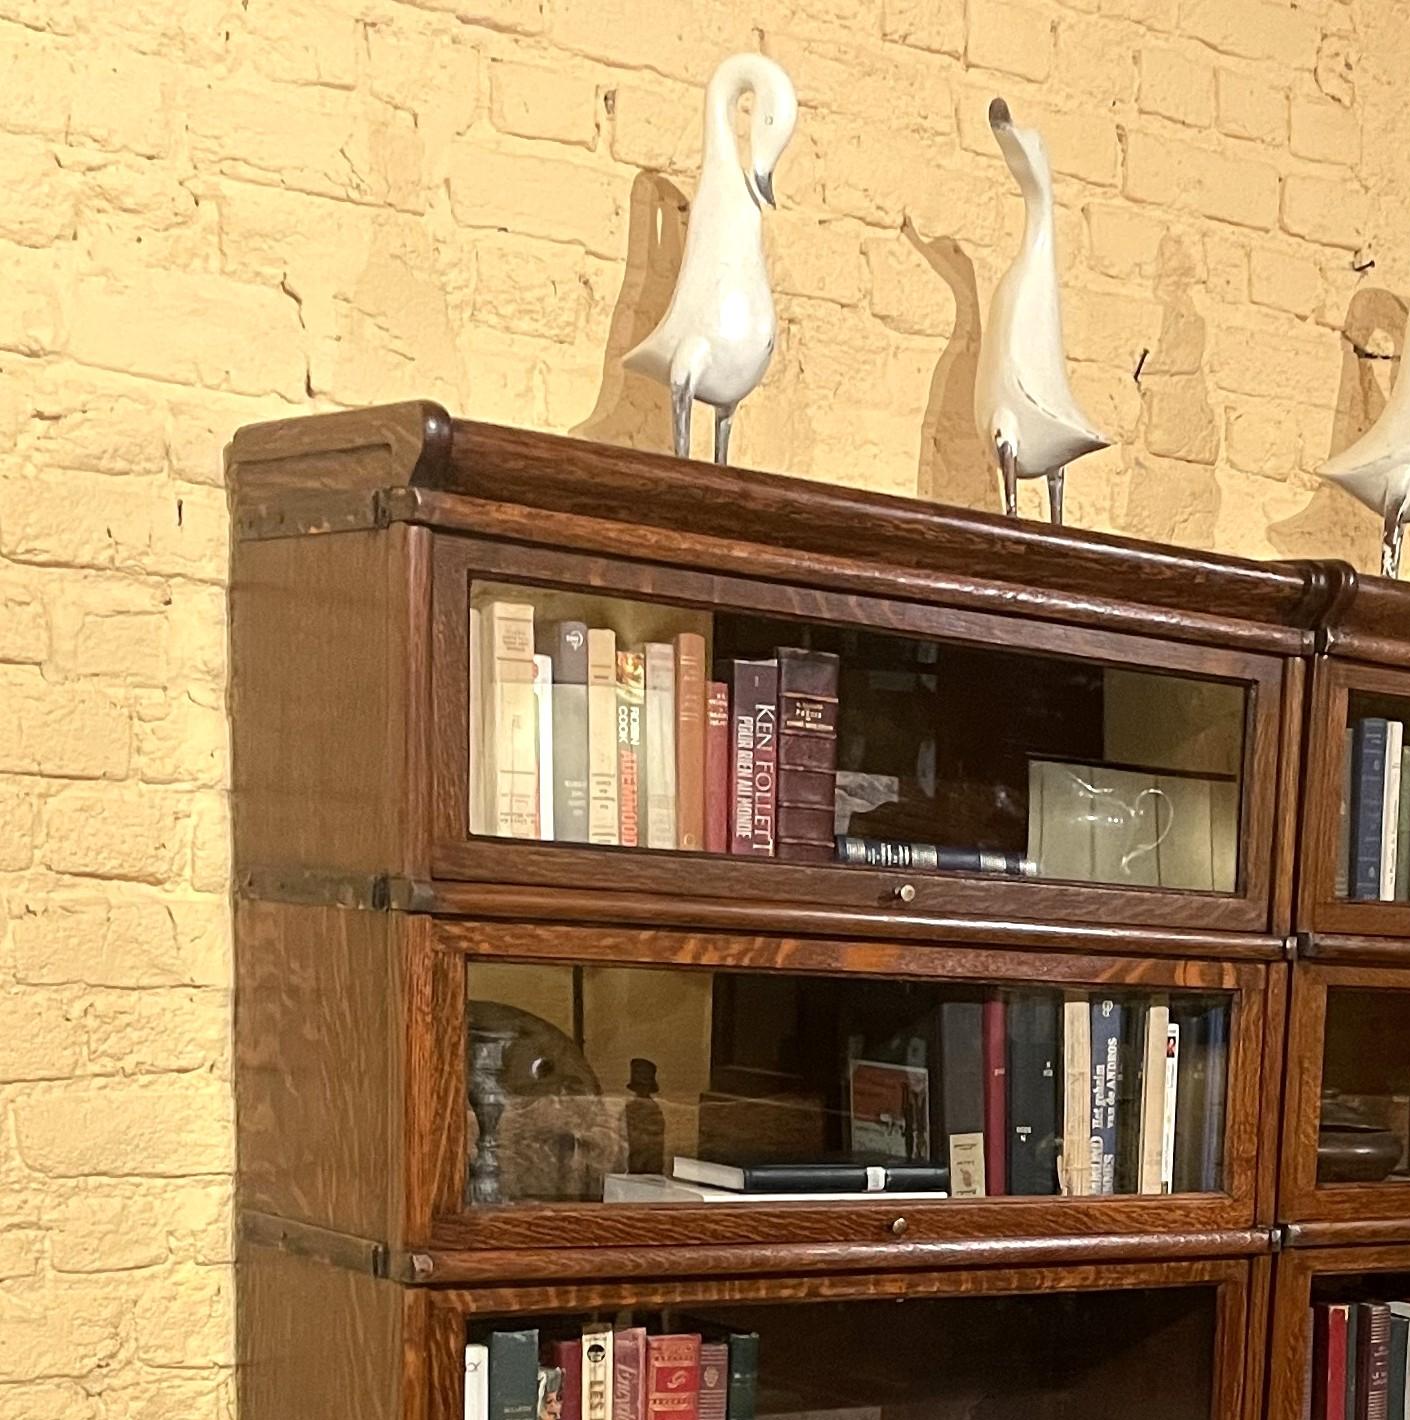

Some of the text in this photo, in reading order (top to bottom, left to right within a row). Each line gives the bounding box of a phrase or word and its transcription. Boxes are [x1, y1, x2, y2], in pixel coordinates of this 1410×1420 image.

[618, 706, 629, 744] COOK
[629, 707, 641, 746] ROBIN
[620, 750, 638, 847] ADEMNOOD
[735, 715, 754, 840] POUR RIEN AU MONDE
[752, 704, 776, 857] KEN FOLLETT
[1106, 1036, 1118, 1090] ANDROS
[1092, 1064, 1106, 1129] Het geheim
[589, 1380, 604, 1411] LES
